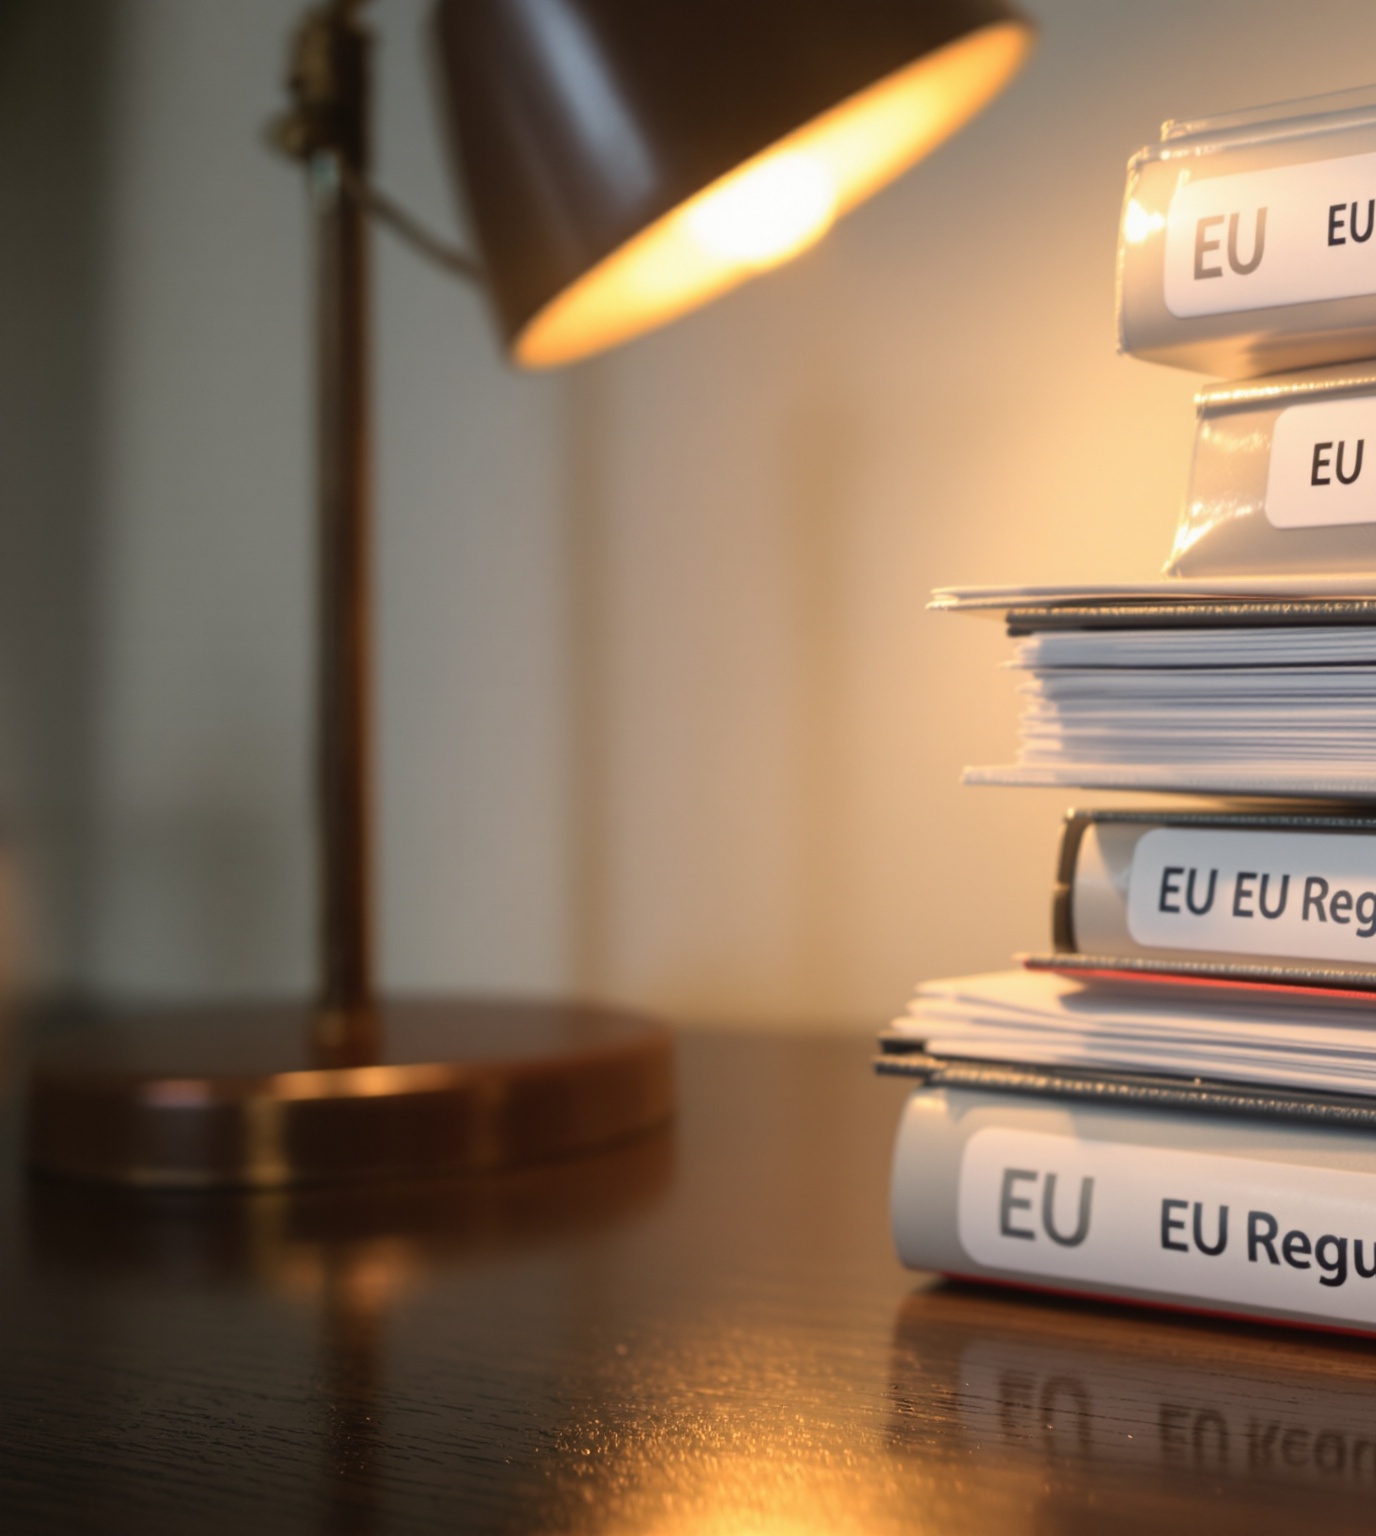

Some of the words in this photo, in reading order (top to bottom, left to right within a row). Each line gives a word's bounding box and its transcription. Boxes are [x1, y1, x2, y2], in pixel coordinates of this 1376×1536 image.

[1193, 209, 1267, 281] EU
[1327, 198, 1376, 248] EU
[1310, 438, 1365, 487] EU
[1157, 865, 1219, 917] EU
[1231, 870, 1291, 921] EU
[999, 1167, 1095, 1249] EU
[1159, 1197, 1230, 1257] EU
